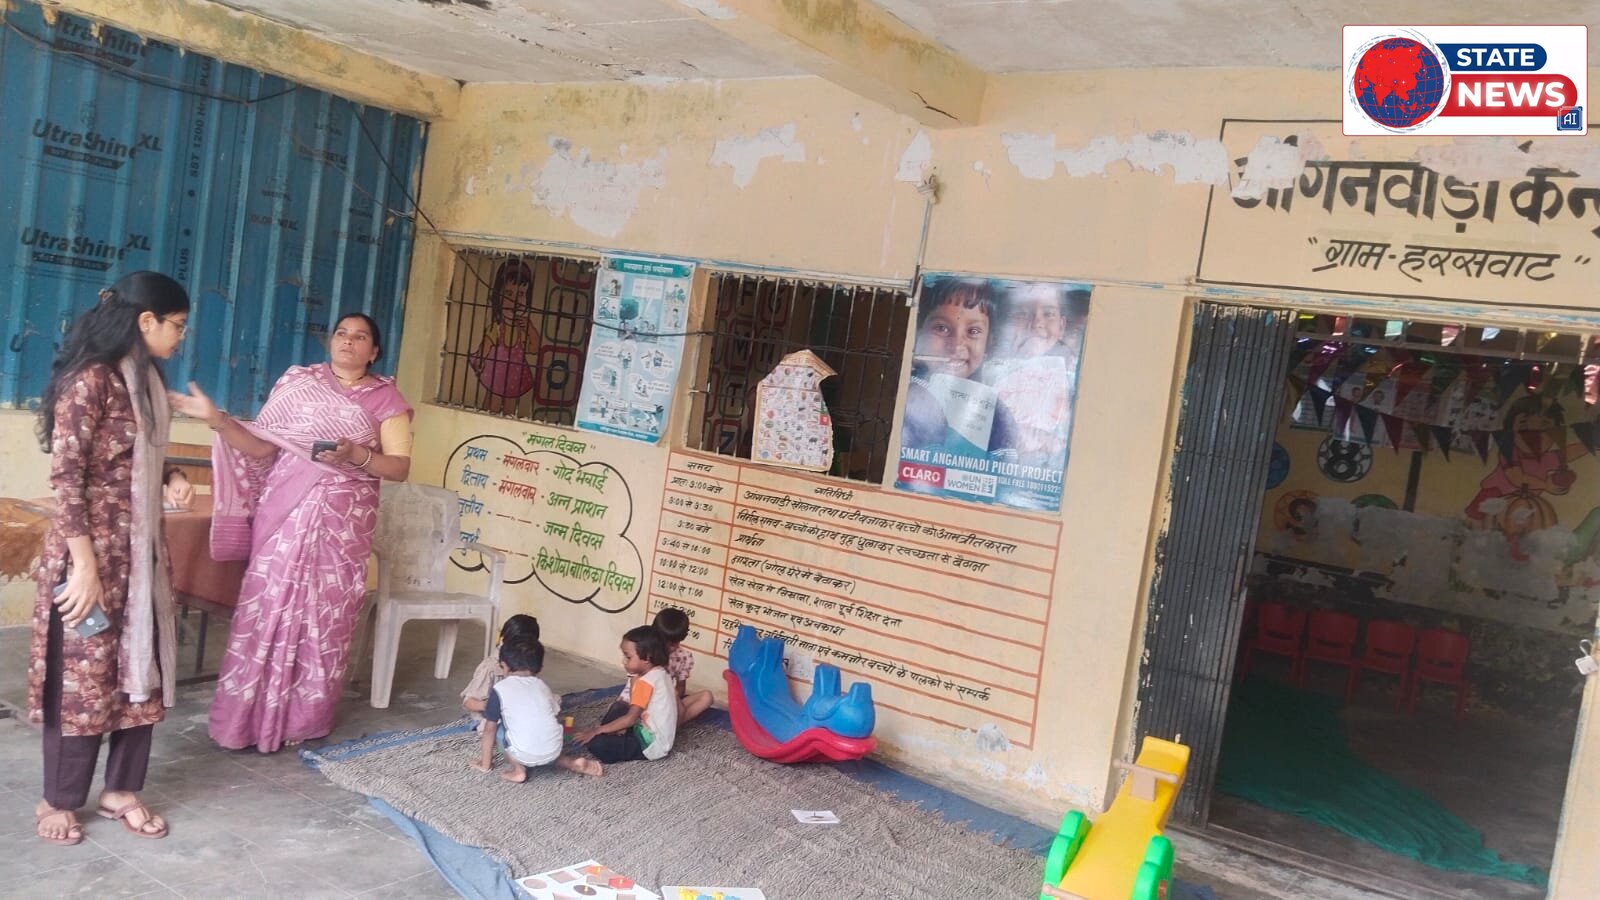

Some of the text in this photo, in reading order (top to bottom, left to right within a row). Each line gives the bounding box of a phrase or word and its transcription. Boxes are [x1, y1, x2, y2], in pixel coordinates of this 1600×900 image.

[127, 233, 152, 250] XL
[178, 247, 190, 281] PLUS
[901, 447, 1063, 484] SMART ANGANWADI PILOT PROJECT
[902, 466, 941, 482] CLARO
[969, 474, 981, 483] UN
[947, 479, 980, 492] WOMEN
